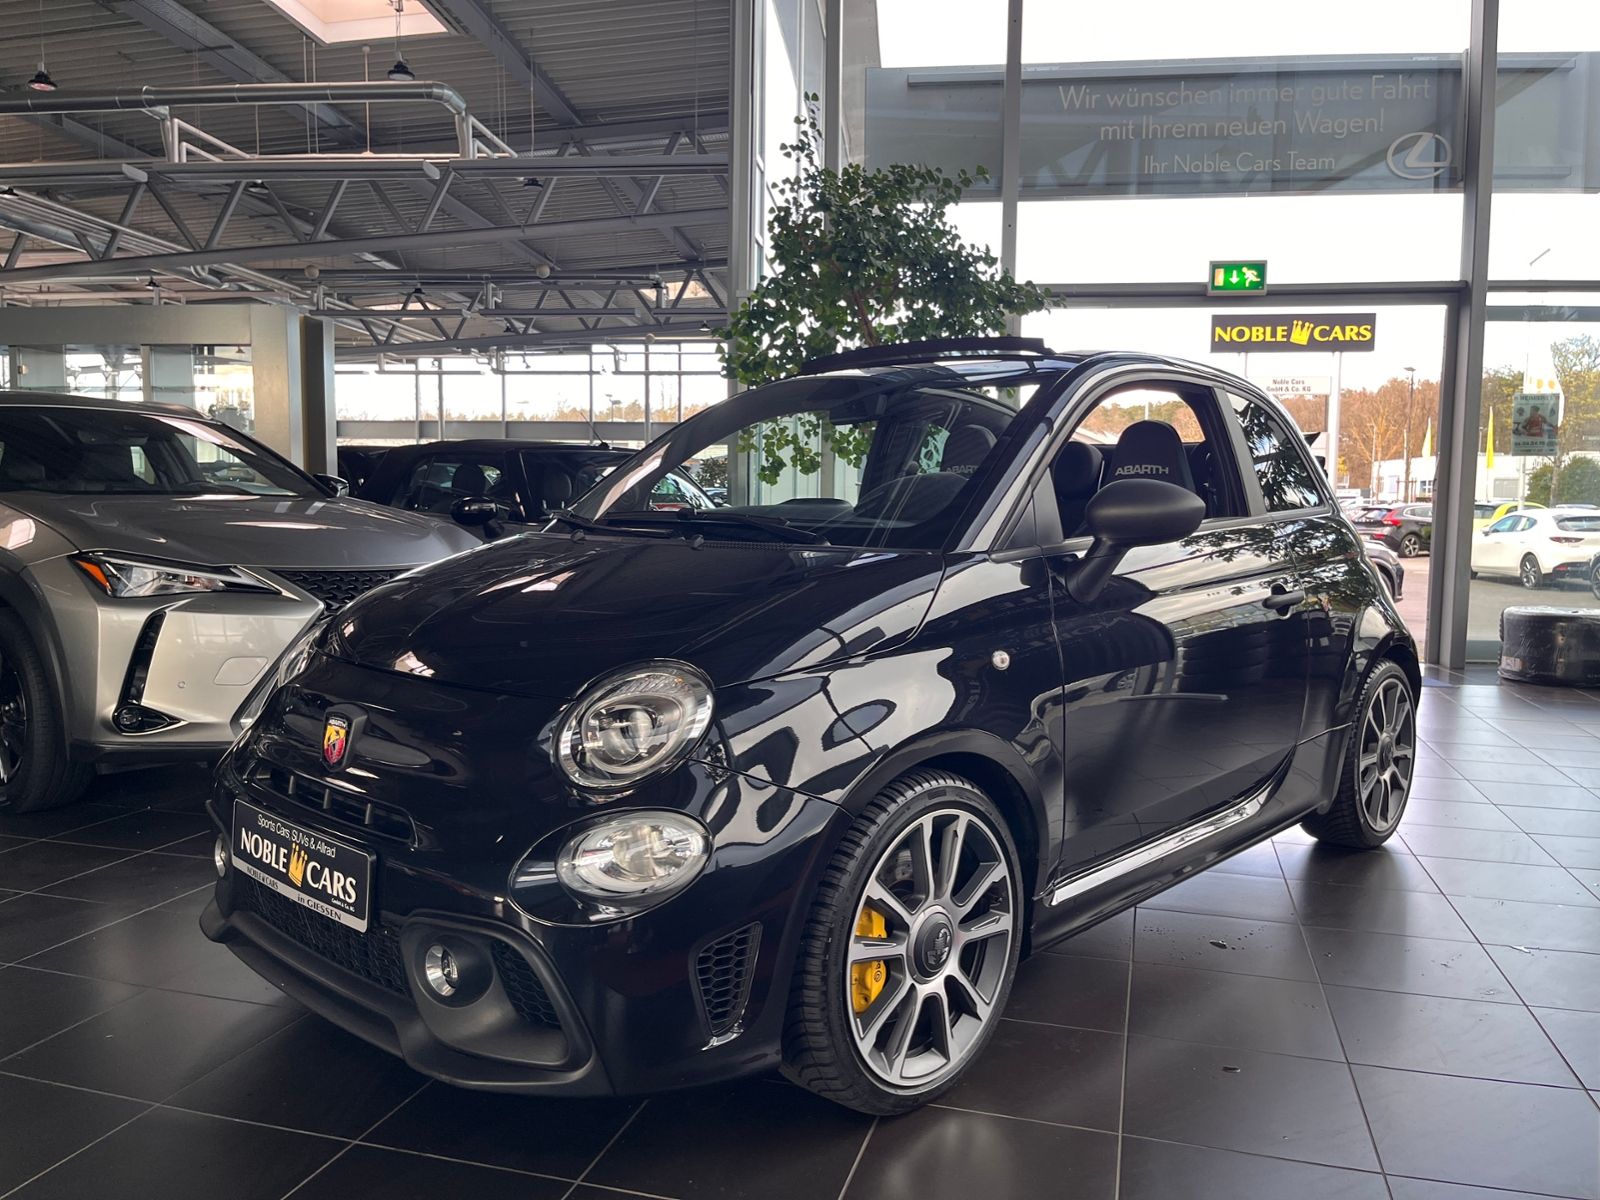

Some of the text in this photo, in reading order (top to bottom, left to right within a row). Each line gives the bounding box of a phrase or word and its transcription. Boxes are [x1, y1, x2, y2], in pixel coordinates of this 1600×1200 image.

[1059, 74, 1431, 110] Wir wünschen immer gute Fahrt
[1100, 107, 1385, 141] mit Ihrem neuen Wagen!
[1145, 151, 1336, 175] Ihr Noble Cars Team
[1214, 324, 1373, 342] NOBLE CARS
[946, 464, 979, 474] ABART
[1115, 464, 1169, 476] ABARTH
[257, 814, 276, 832] Sports
[309, 837, 316, 850] &
[316, 841, 336, 858] Allrad
[240, 827, 357, 904] NOBLE CARS
[246, 866, 280, 891] NOBLE CARS
[297, 893, 342, 920] in GIESSEN
